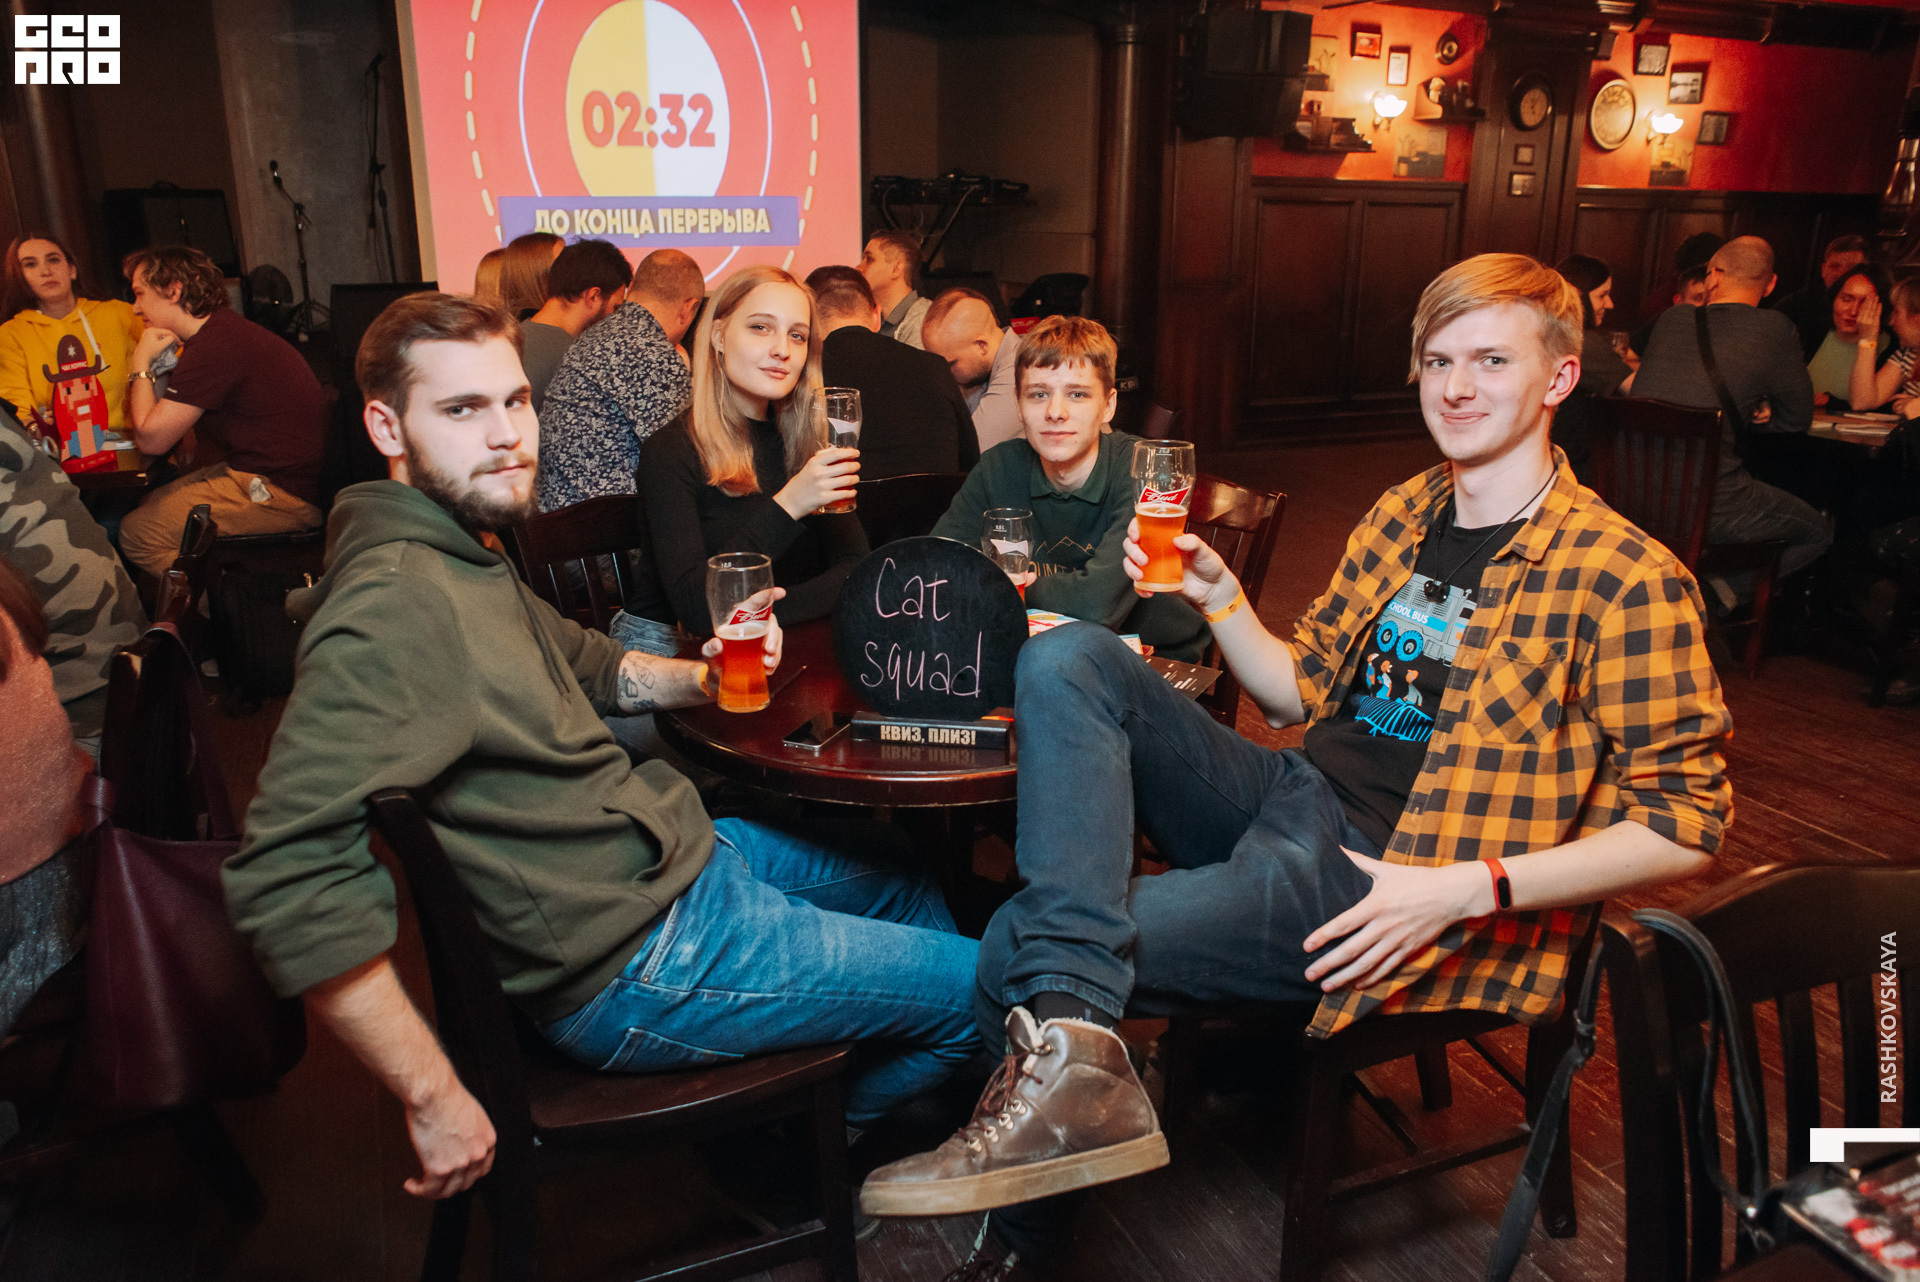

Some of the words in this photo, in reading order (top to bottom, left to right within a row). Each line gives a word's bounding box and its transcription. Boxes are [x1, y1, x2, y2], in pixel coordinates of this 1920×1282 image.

[582, 90, 716, 149] 02:32
[534, 208, 571, 235] ДО
[574, 207, 655, 238] КОНЦА
[658, 207, 771, 234] ПЕРЕРЫВА
[875, 557, 951, 621] Cat
[1412, 611, 1429, 624] BUS
[880, 725, 925, 743] КВИЗ,
[928, 727, 976, 745] ПЛИЗ!
